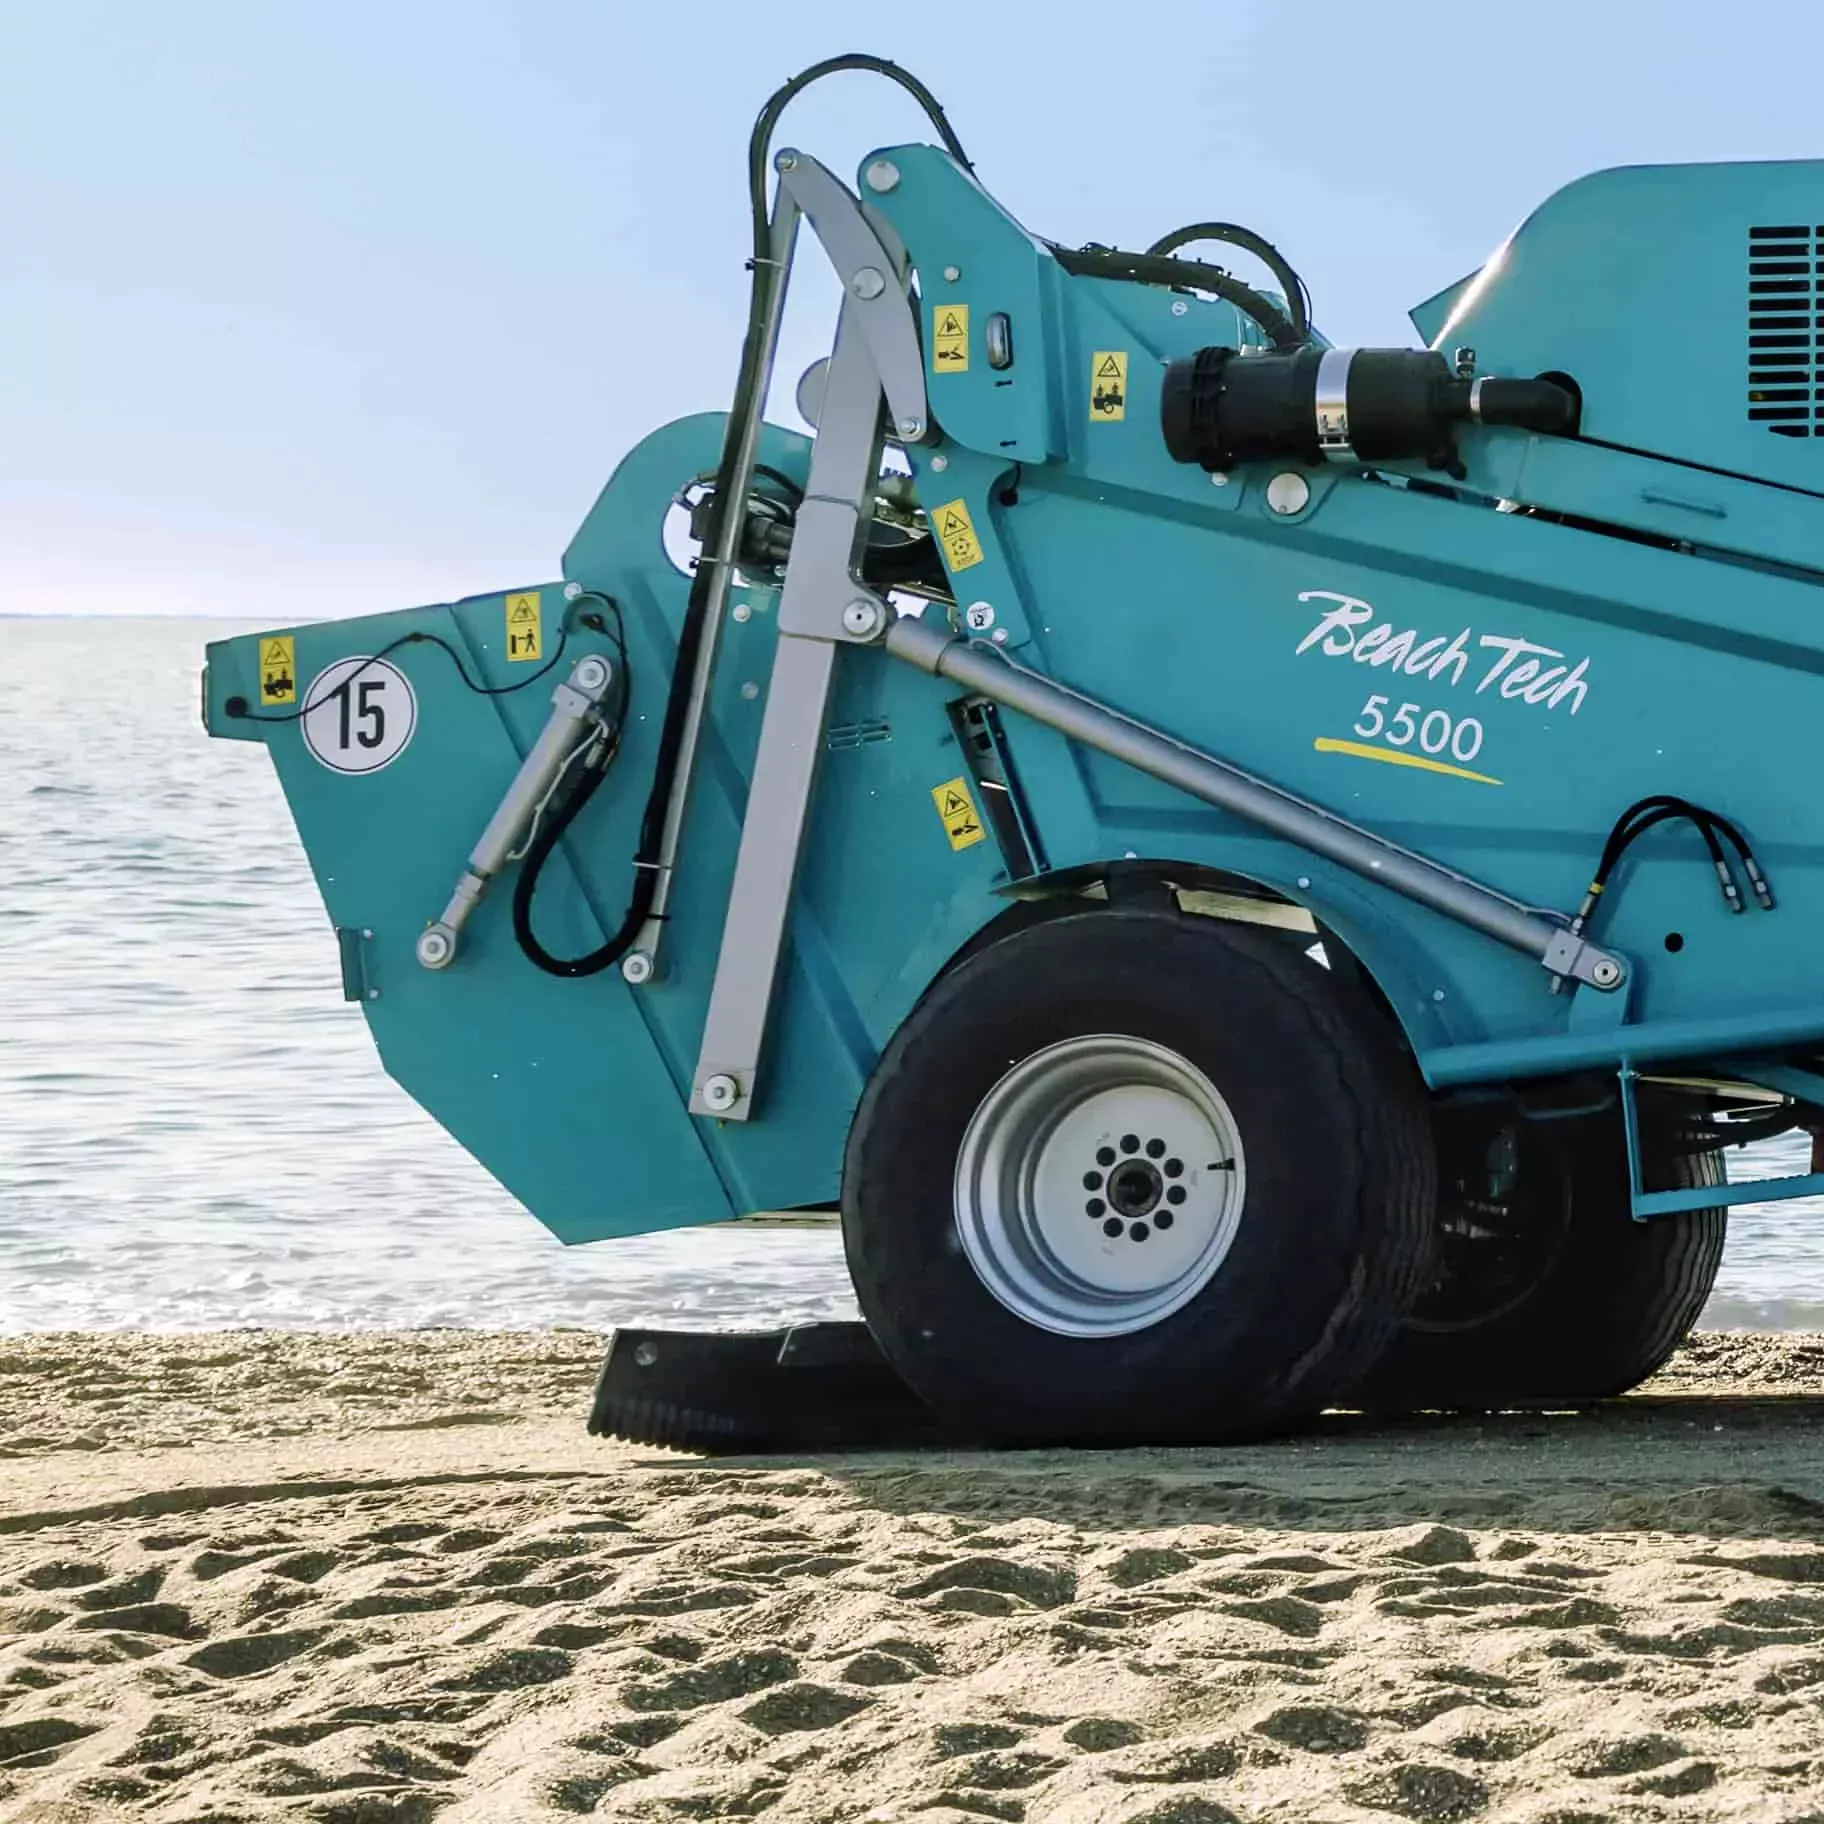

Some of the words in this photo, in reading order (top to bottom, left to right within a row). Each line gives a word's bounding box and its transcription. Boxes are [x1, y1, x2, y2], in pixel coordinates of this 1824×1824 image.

[1295, 590, 1471, 686] Beach
[1475, 633, 1591, 716] Tech
[330, 680, 385, 749] 15
[1353, 694, 1484, 762] 5500
